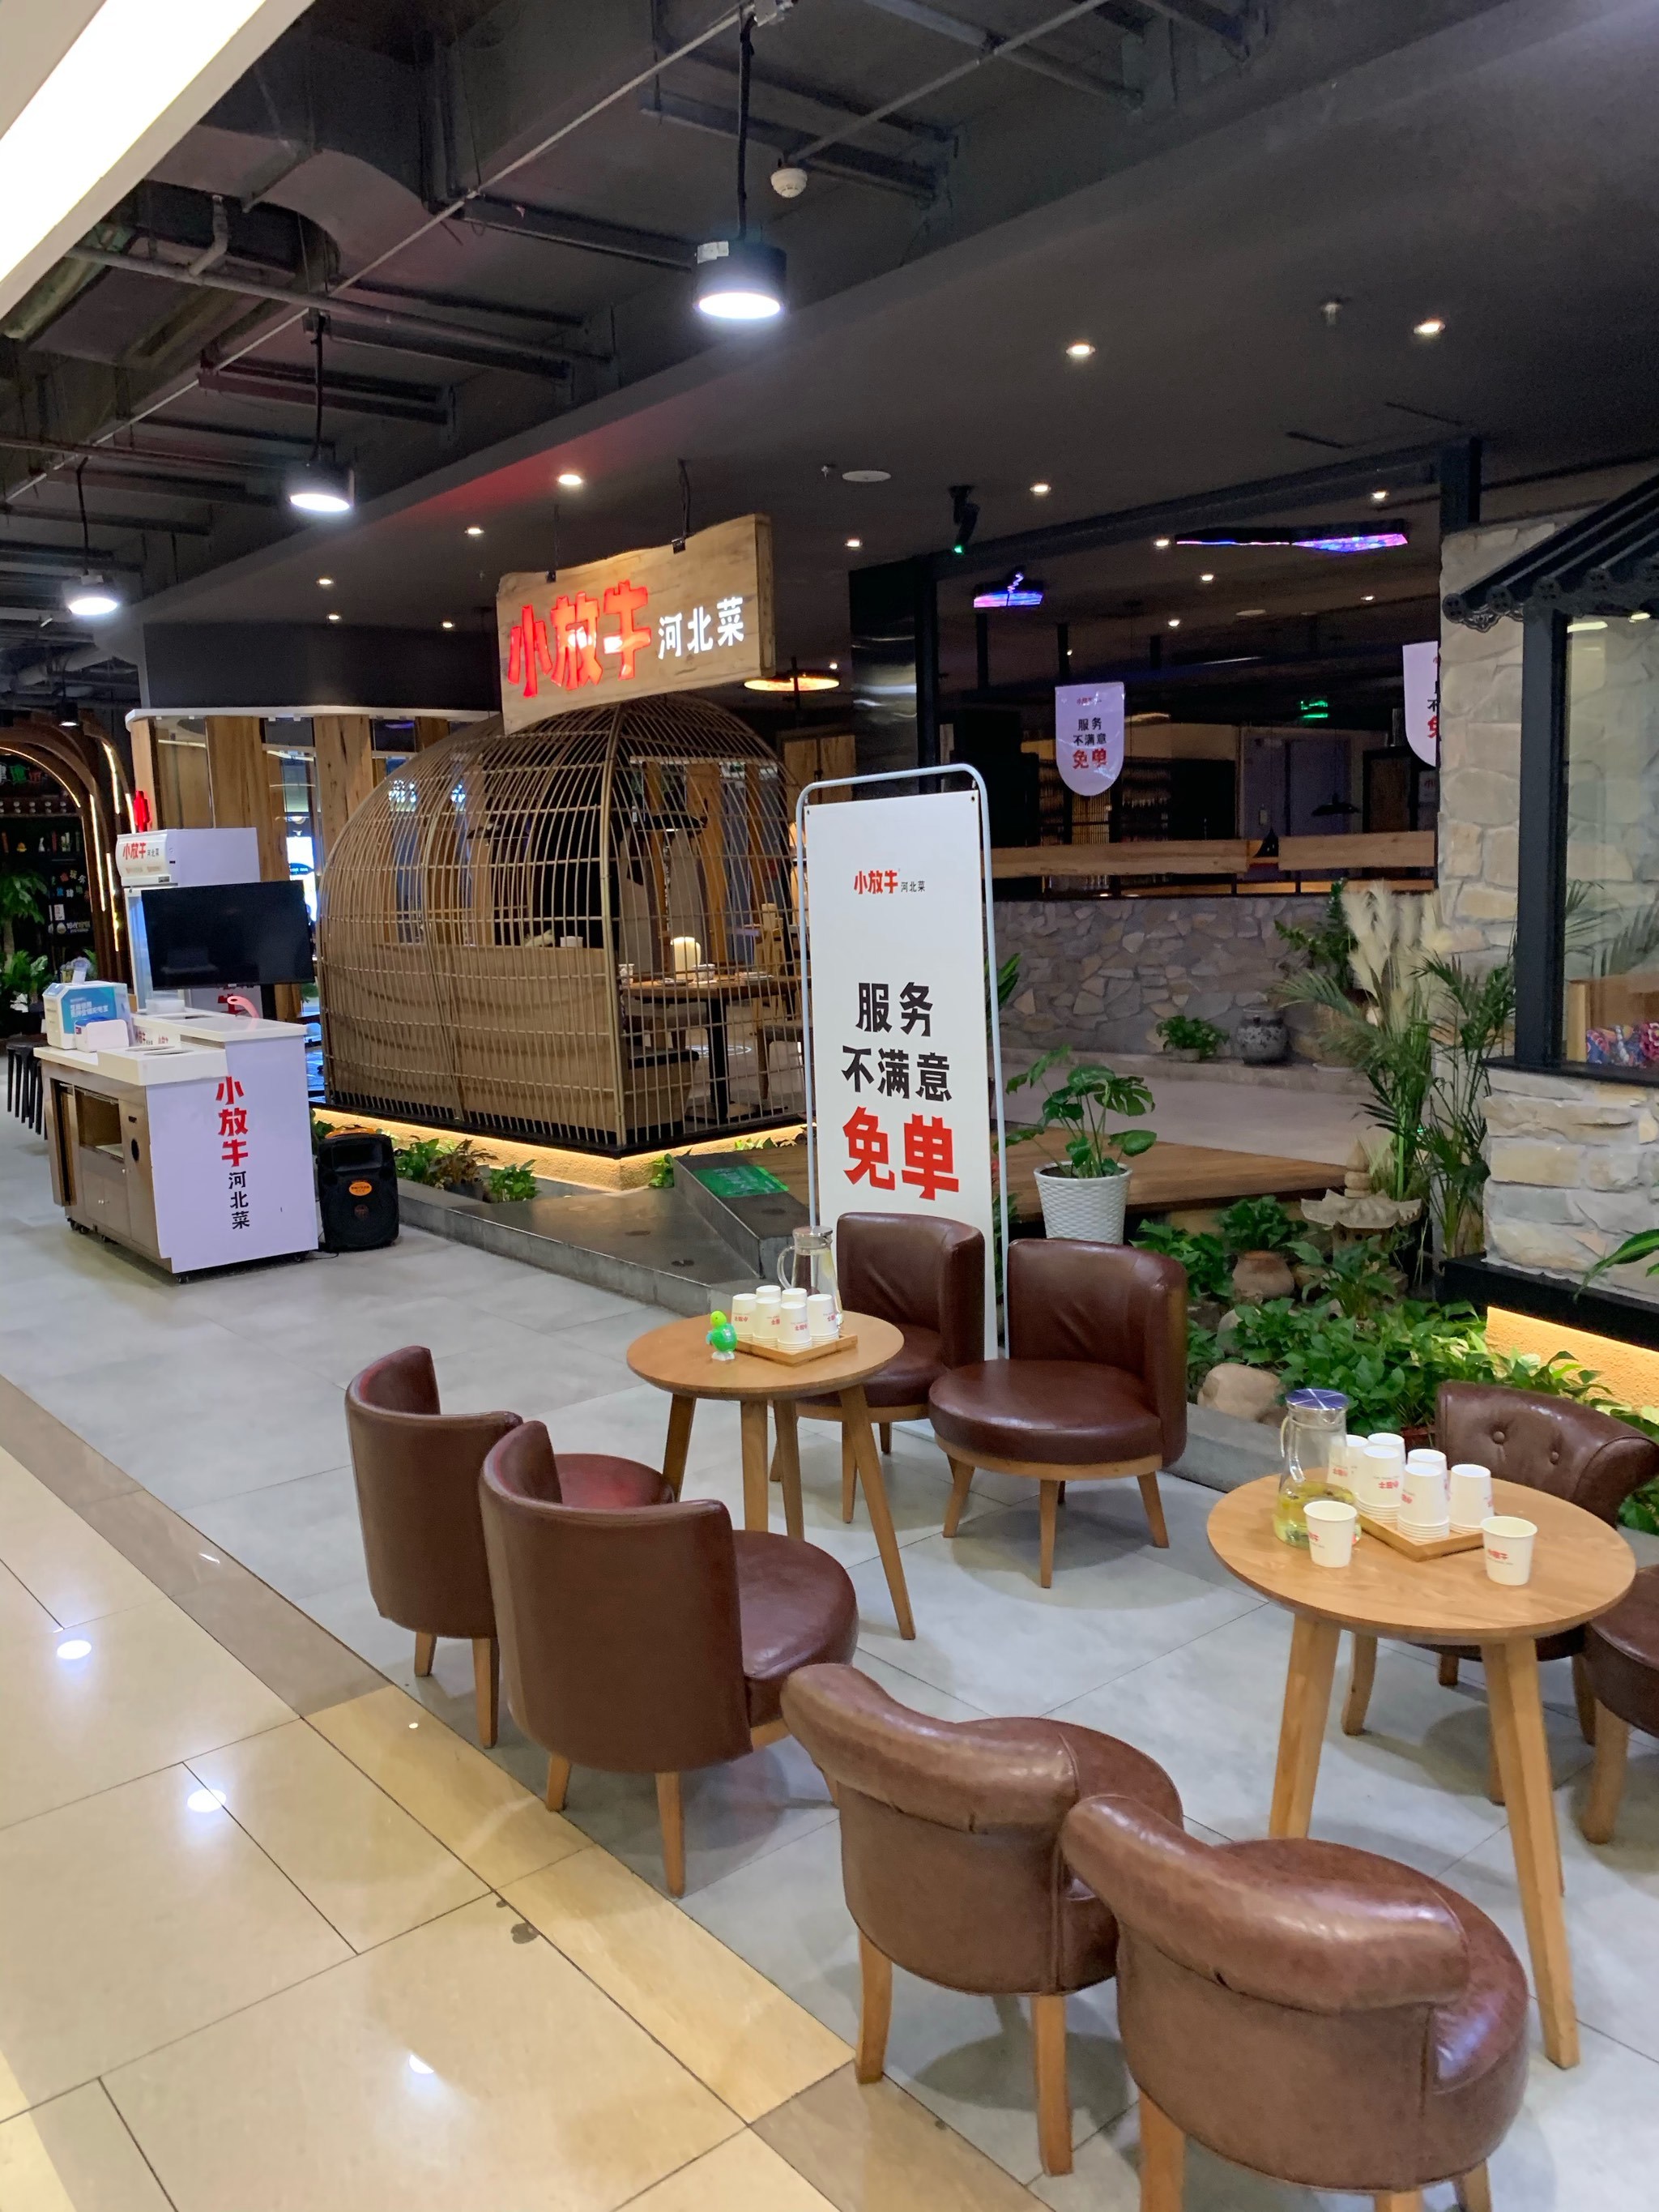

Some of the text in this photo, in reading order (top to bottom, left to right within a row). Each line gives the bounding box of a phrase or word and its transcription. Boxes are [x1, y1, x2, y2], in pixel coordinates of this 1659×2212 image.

[508, 580, 744, 698] 小放牛 河北菜
[1073, 733, 1107, 745] 不满意
[1078, 717, 1102, 731] 服务
[1073, 748, 1107, 769] 免单
[123, 843, 147, 860] 小放牛
[854, 869, 925, 895] 小放牛 河北菜
[855, 981, 933, 1038] 服务
[842, 1045, 953, 1102] 不满意
[216, 1076, 250, 1229] 小放牛 河北菜
[842, 1106, 959, 1201] 免单
